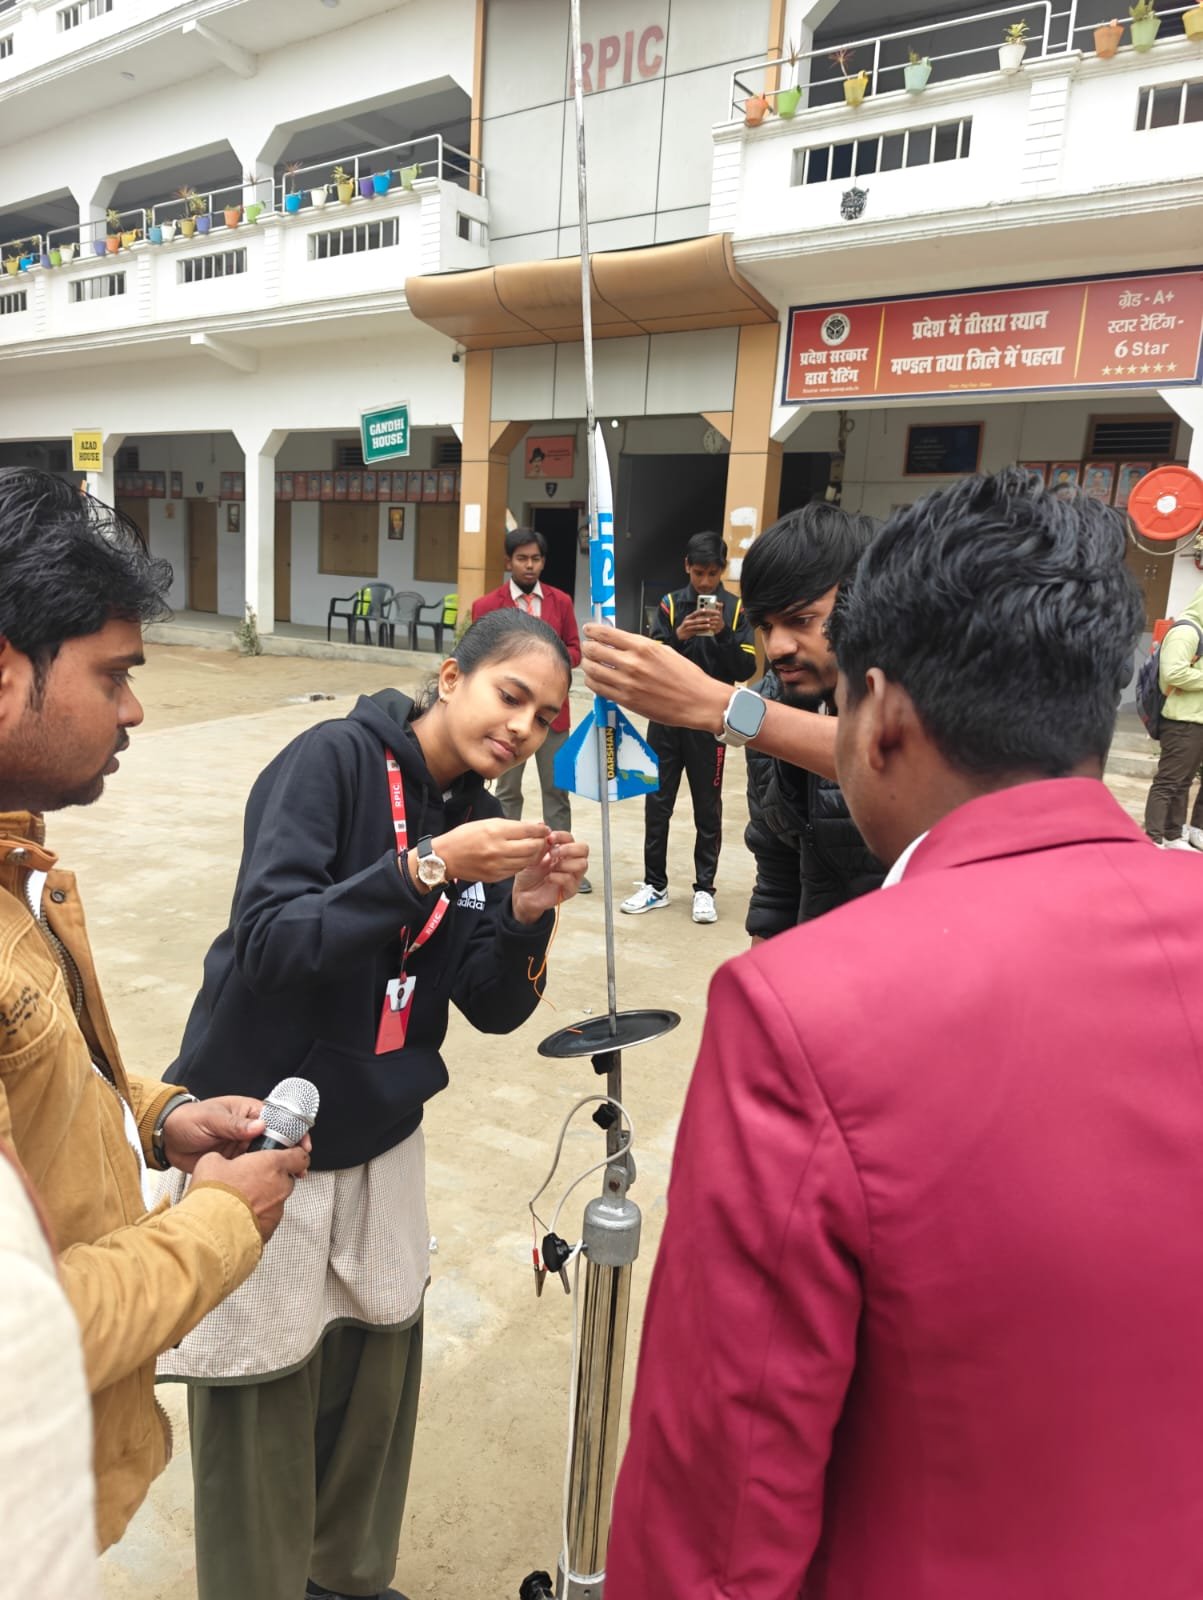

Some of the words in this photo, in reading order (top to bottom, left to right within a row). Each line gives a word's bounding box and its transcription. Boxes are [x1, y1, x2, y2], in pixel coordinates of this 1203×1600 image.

[570, 25, 664, 97] RPIC
[1152, 289, 1175, 305] A+
[912, 316, 946, 340] प्रदेश
[949, 313, 963, 336] में
[964, 311, 1007, 335] तीसरा
[1107, 318, 1138, 334] स्टार
[1139, 312, 1177, 331] रेटिंग
[799, 348, 828, 366] प्रदेश
[829, 347, 870, 364] सरकार
[890, 355, 934, 375] मण्डल
[966, 346, 1002, 371] जिले
[1004, 344, 1021, 368] में
[1020, 346, 1066, 367] पहला
[1114, 339, 1129, 358] 6
[1131, 341, 1170, 356] Star
[369, 417, 405, 435] GANDHI
[372, 432, 404, 449] HOUSE
[79, 452, 100, 462] HOUSE
[606, 727, 615, 778] DARSHAN
[393, 783, 402, 808] RPIC
[425, 912, 441, 936] RPIC
